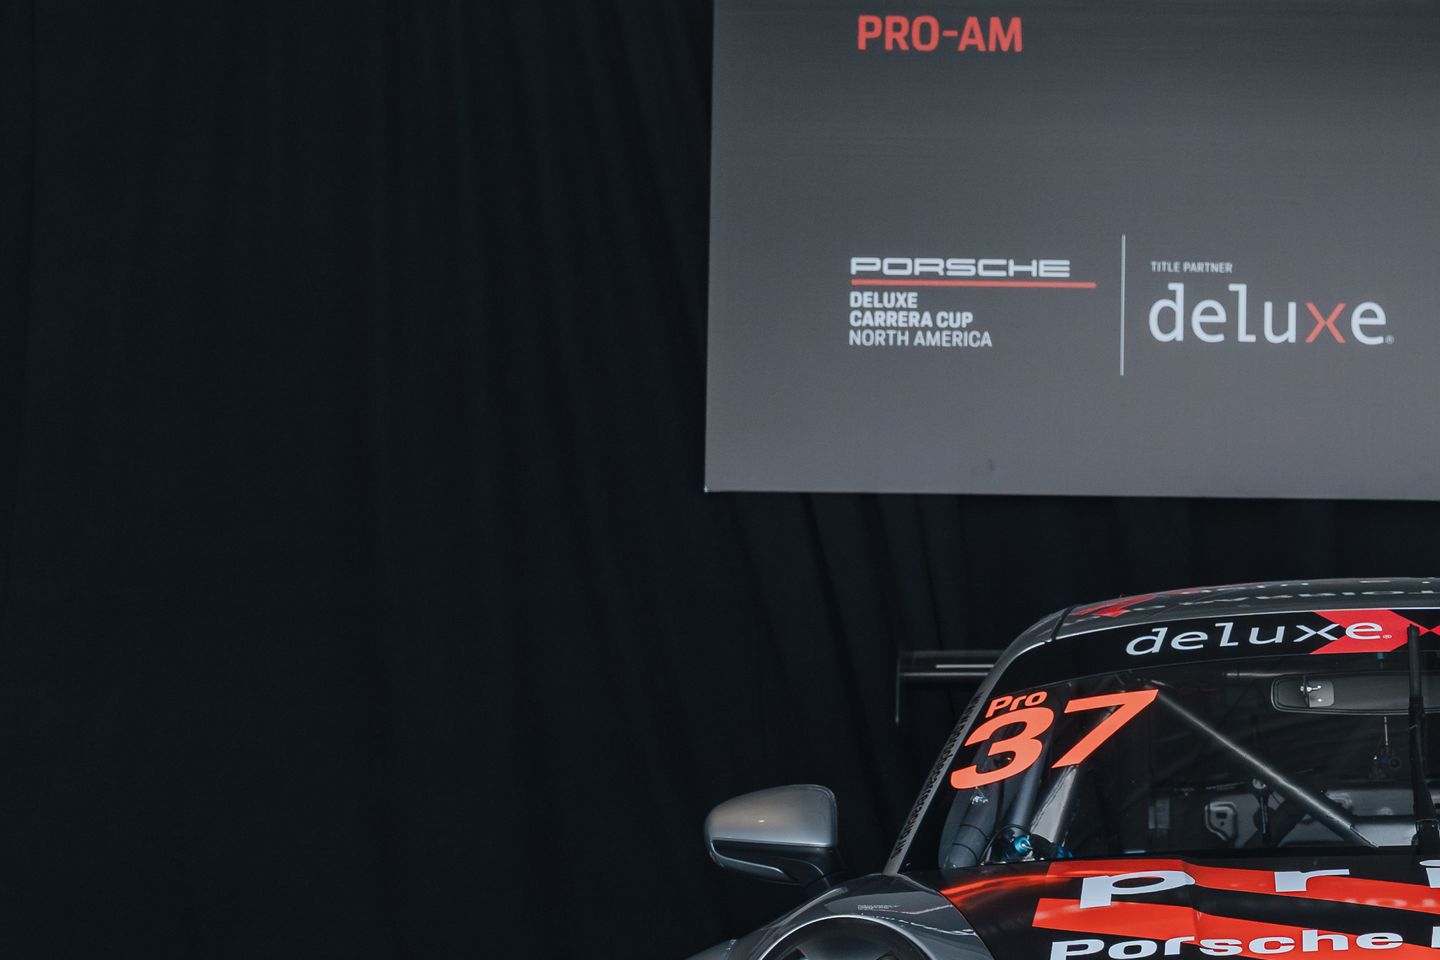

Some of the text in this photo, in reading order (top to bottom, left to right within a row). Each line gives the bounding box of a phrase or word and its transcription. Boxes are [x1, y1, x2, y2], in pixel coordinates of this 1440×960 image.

[857, 15, 1023, 53] PRO-AM
[851, 257, 1071, 278] PORSCHE
[1150, 261, 1233, 275] TITLE PARTNER
[850, 291, 918, 310] DELUXE
[849, 310, 974, 330] CARRERA CUP
[848, 329, 993, 349] NORTH AMERICA
[985, 691, 1048, 719] Pro
[950, 688, 1159, 789] 37
